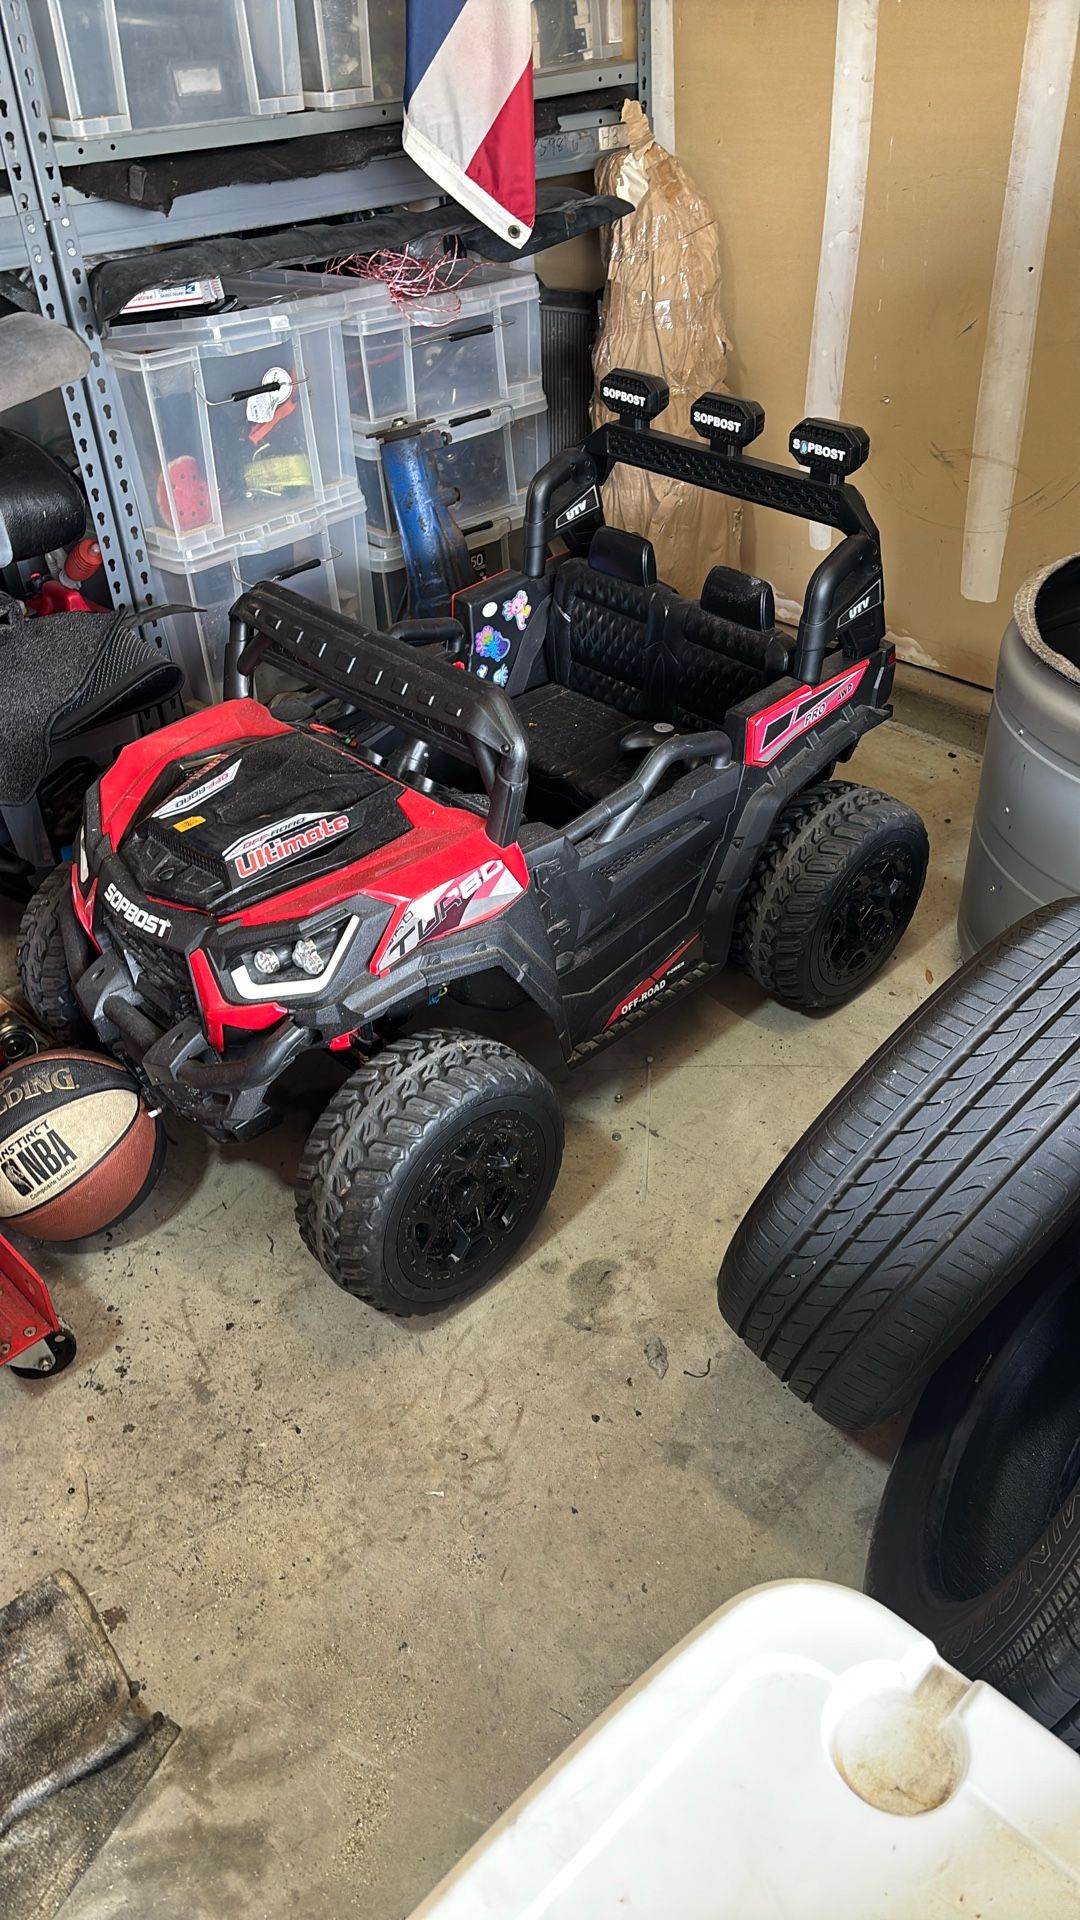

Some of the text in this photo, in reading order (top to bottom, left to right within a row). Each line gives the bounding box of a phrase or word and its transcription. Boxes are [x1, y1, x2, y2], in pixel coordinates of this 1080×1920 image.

[601, 126, 619, 148] H3
[602, 386, 646, 407] SOPBOST
[693, 411, 742, 433] SOPBOST
[792, 438, 846, 462] SPBOST
[565, 499, 587, 521] UTV
[849, 596, 870, 619] UTV
[804, 702, 827, 727] PRO
[234, 814, 350, 879] Ultimate
[242, 816, 307, 850] OFF-ROAD
[103, 882, 172, 938] SOPBOST
[388, 860, 504, 956] TURBO
[621, 979, 667, 1015] OFF-ROAD
[0, 1067, 76, 1114] DING
[0, 1119, 49, 1163] NSTINCT
[16, 1129, 78, 1186] NBA
[30, 1165, 78, 1201] Composite Leather
